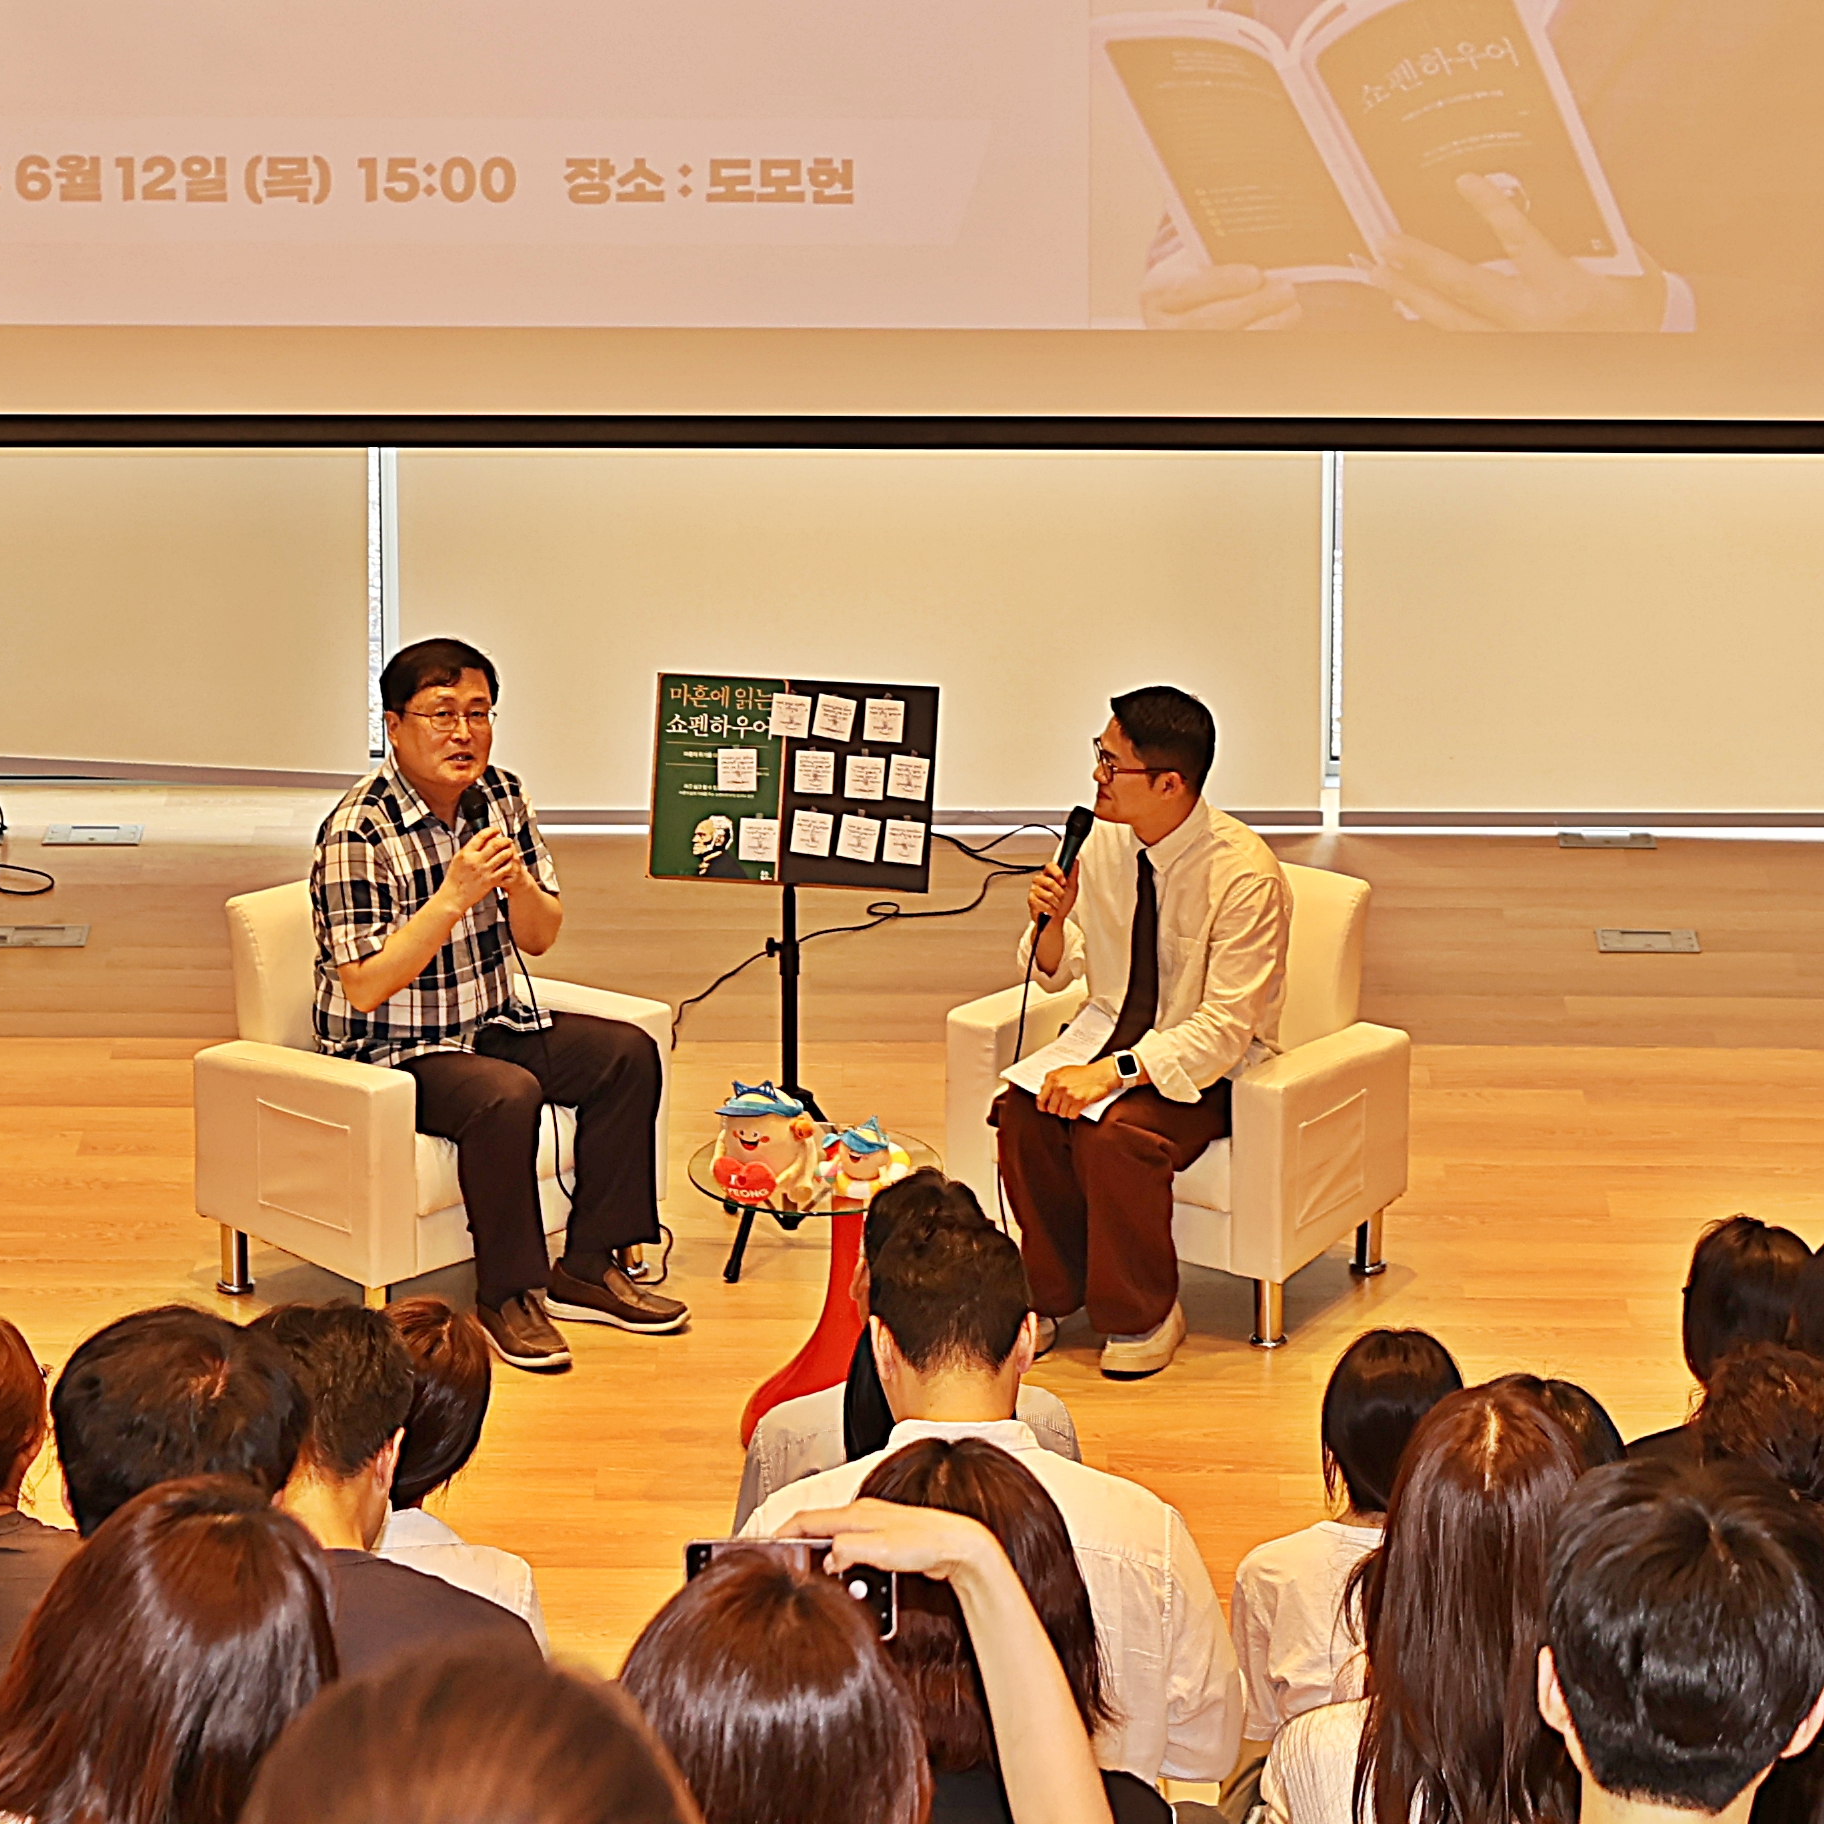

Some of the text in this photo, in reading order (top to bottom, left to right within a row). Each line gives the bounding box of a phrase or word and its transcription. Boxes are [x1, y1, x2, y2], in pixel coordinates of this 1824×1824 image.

[15, 154, 103, 203] 6월
[114, 155, 228, 203] 12일
[244, 154, 332, 205] (목)
[357, 156, 517, 204] 15:00
[563, 157, 666, 205] 장소
[705, 157, 855, 205] 도모헌
[669, 682, 774, 711] 마흔에 읽는
[665, 712, 773, 740] 쇼펜하우어
